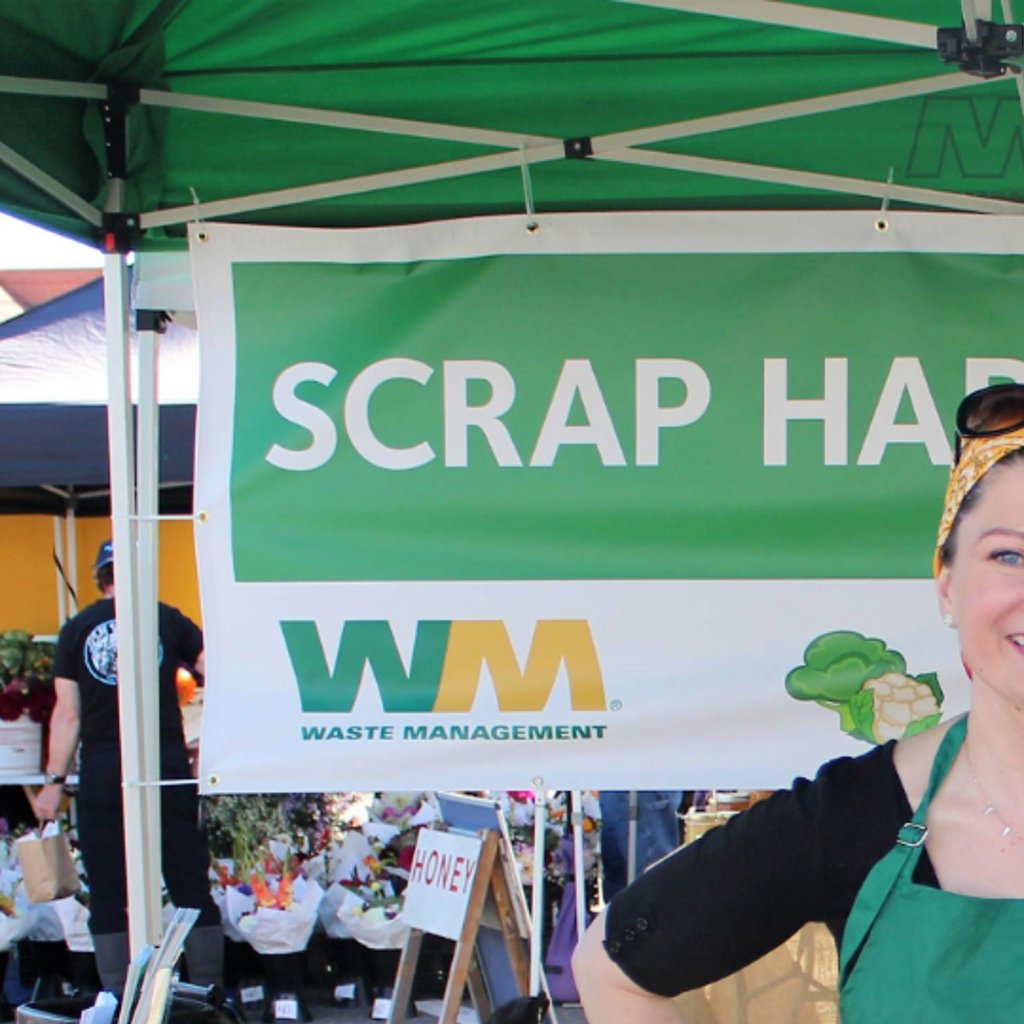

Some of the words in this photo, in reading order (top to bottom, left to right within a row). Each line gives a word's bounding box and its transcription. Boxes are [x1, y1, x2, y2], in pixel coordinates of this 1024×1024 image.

[265, 357, 711, 470] SCRAP
[279, 619, 607, 713] WM
[301, 726, 394, 741] WASTE
[402, 725, 607, 741] MANAGEMENT
[411, 849, 476, 894] HONEY
